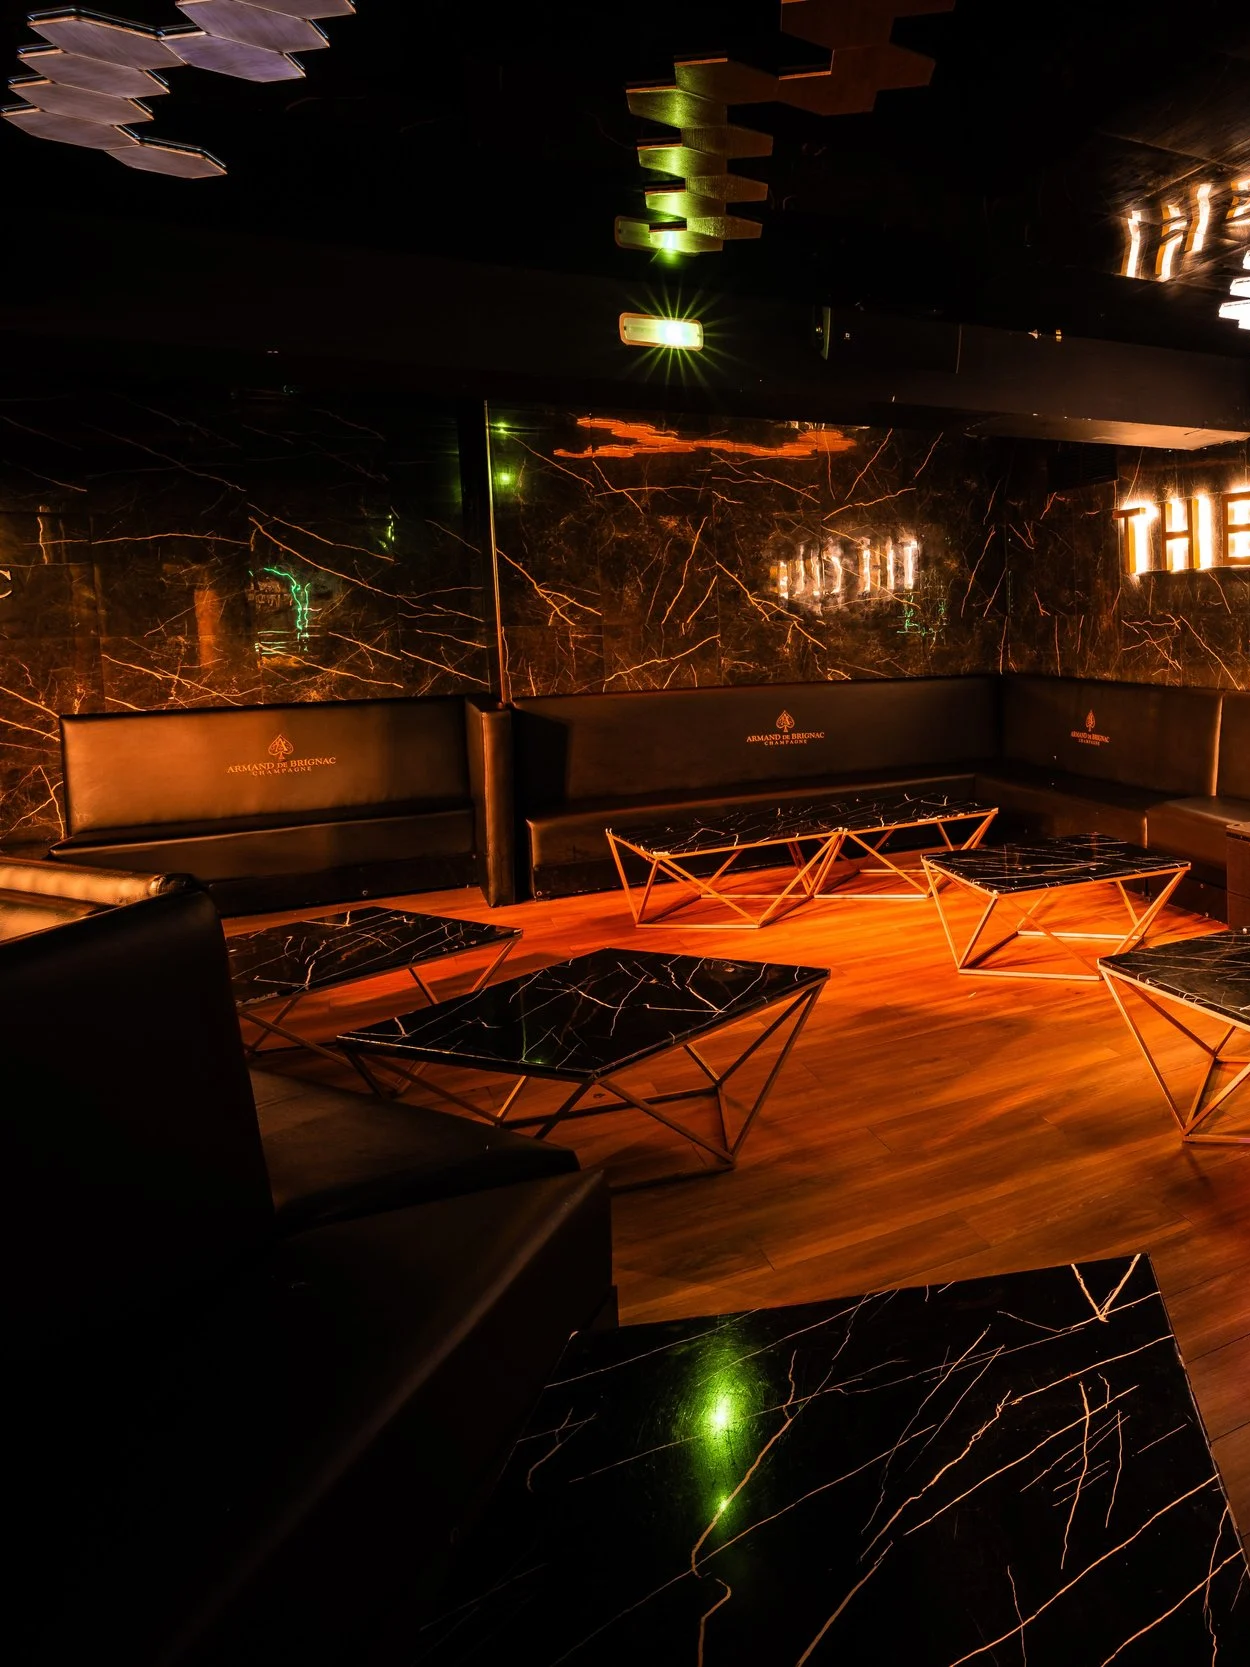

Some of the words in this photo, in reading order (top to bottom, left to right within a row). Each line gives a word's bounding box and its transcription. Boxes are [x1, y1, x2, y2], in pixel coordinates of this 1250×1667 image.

[746, 733, 781, 743] ARMAND
[791, 732, 825, 740] BRIGNAC
[227, 761, 275, 774] ARMAND
[277, 761, 288, 769] DE
[290, 757, 337, 769] BRIGNAC
[252, 766, 312, 777] CHAMPAGNE
